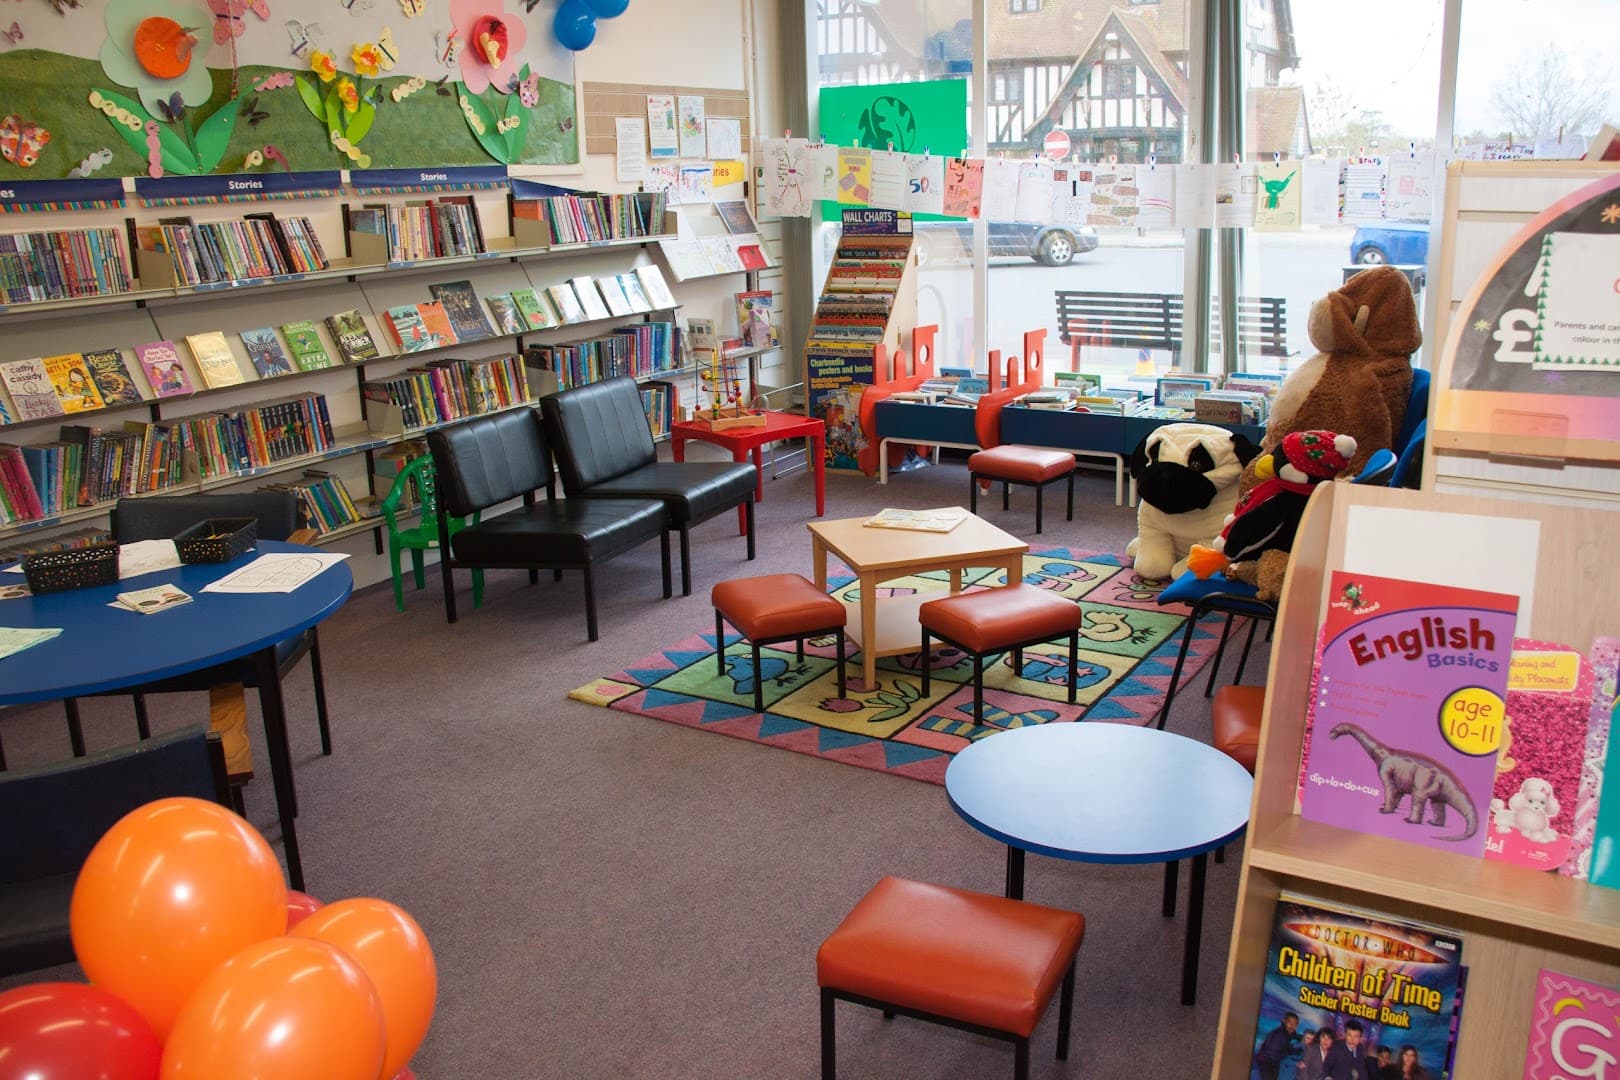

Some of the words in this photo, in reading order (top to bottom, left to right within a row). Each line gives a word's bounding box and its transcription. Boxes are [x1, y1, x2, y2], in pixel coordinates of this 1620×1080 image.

[420, 172, 448, 182] Stories
[228, 179, 263, 191] Stories
[843, 211, 863, 223] WALL
[864, 211, 893, 223] CHARTS
[1554, 320, 1587, 330] Parents
[1589, 322, 1605, 331] and
[1572, 335, 1601, 344] colour
[301, 353, 328, 364] EXTRA
[10, 364, 34, 374] cathy
[10, 372, 42, 384] cassidy
[25, 407, 57, 419] STAR
[1354, 602, 1381, 615] ahead
[1348, 617, 1496, 668] English
[1427, 652, 1499, 672] Basics
[1453, 699, 1492, 721] age
[1450, 721, 1496, 744] 10-11
[1313, 924, 1370, 951] DOCTOR
[1382, 940, 1417, 961] WHO
[1278, 946, 1358, 992] Children
[1362, 969, 1387, 997] of
[1391, 972, 1443, 1012] Time
[1299, 986, 1340, 1011] Sticker
[1340, 996, 1379, 1021] Poster
[1380, 1005, 1411, 1028] Book
